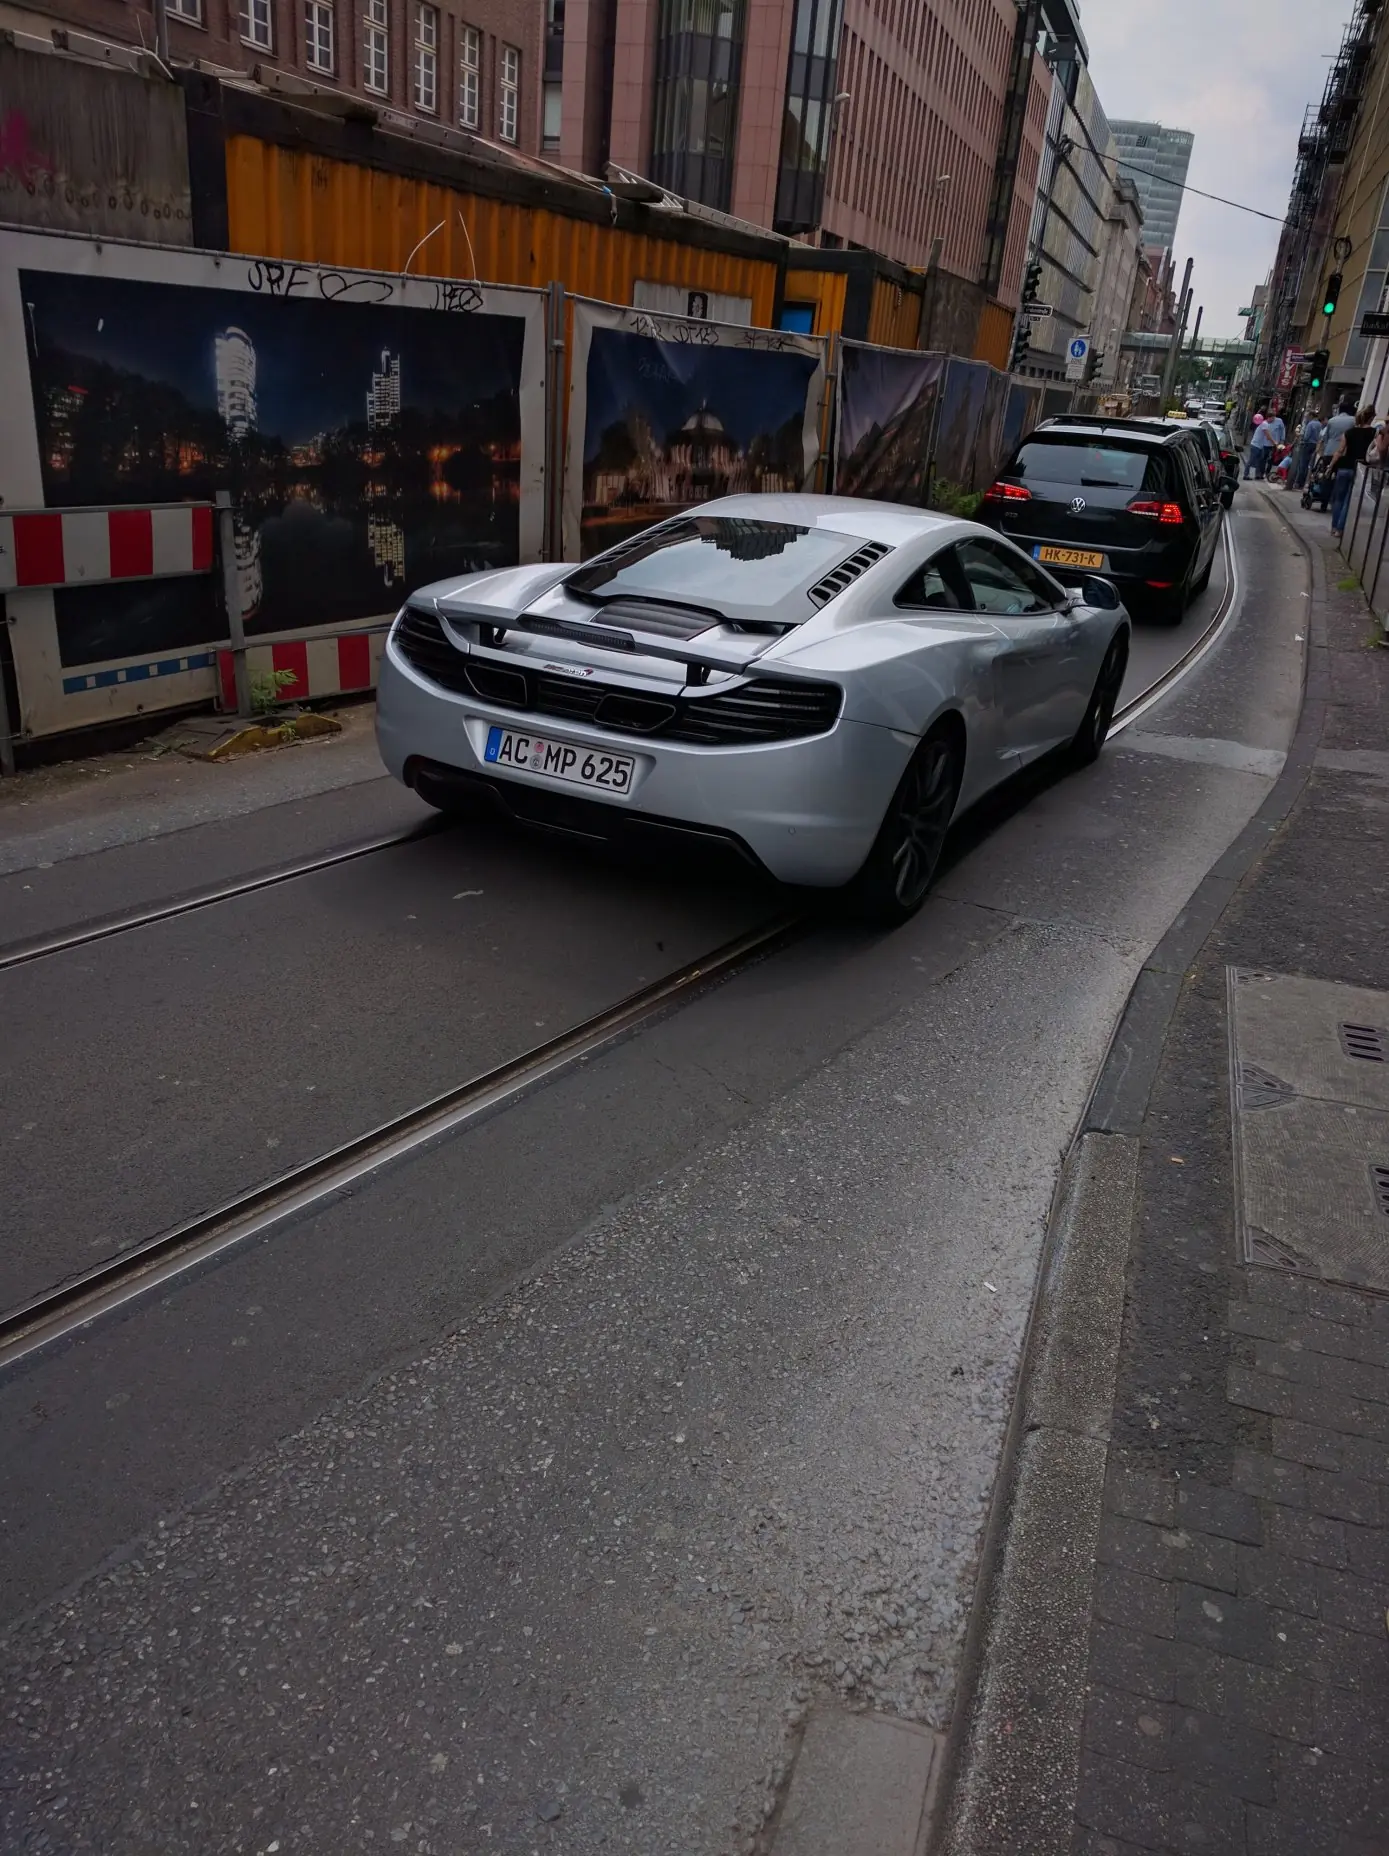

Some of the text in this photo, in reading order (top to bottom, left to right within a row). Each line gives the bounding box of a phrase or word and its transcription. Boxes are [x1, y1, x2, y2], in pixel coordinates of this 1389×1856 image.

[1044, 548, 1096, 566] HK-731-K
[499, 735, 631, 787] AC MP 625
